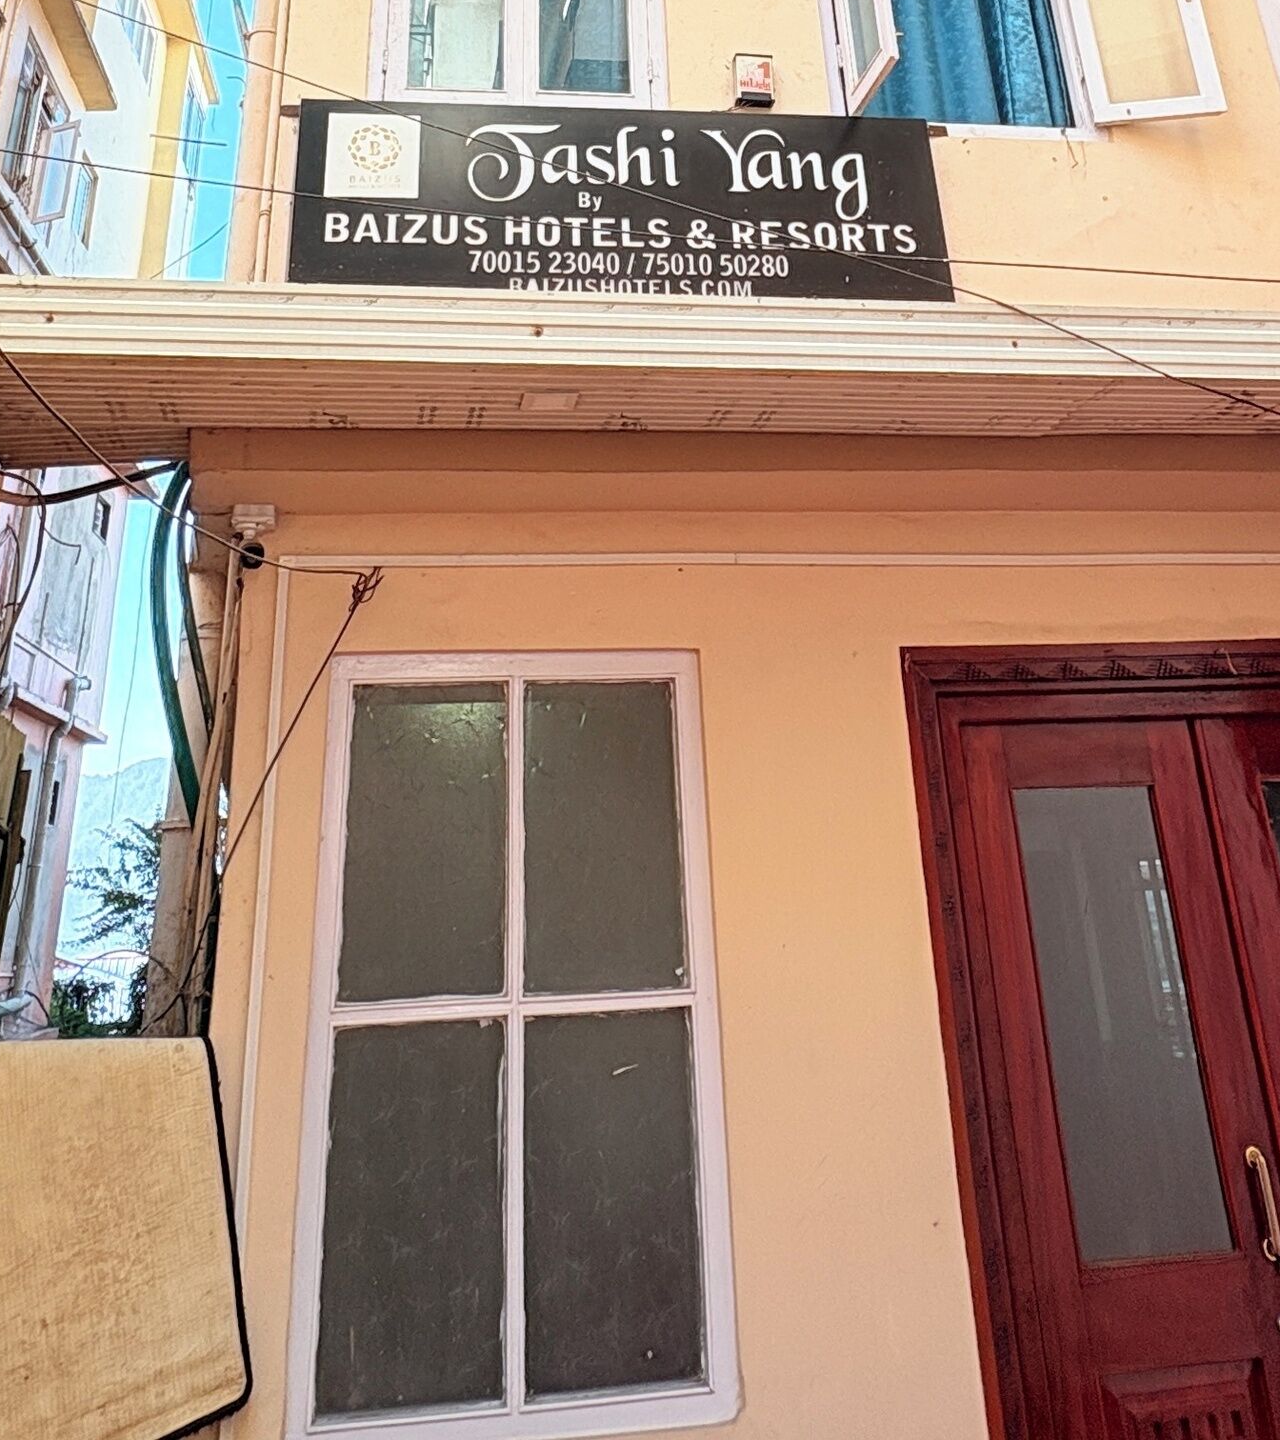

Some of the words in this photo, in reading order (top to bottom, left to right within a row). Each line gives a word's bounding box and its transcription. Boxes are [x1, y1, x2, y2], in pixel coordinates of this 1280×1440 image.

[465, 124, 681, 202] Tashi
[699, 129, 869, 221] Yang
[578, 191, 602, 211] By
[324, 212, 488, 246] BAIZUS
[505, 216, 671, 249] HOTELS
[686, 219, 717, 250] &
[732, 221, 917, 254] RESORTS
[468, 250, 540, 274] 70015
[548, 252, 620, 276] 23040
[626, 253, 636, 275] /
[642, 253, 713, 277] 75010
[720, 254, 790, 278] 50280
[509, 277, 753, 297] BAIZUSHOTELSCOM
